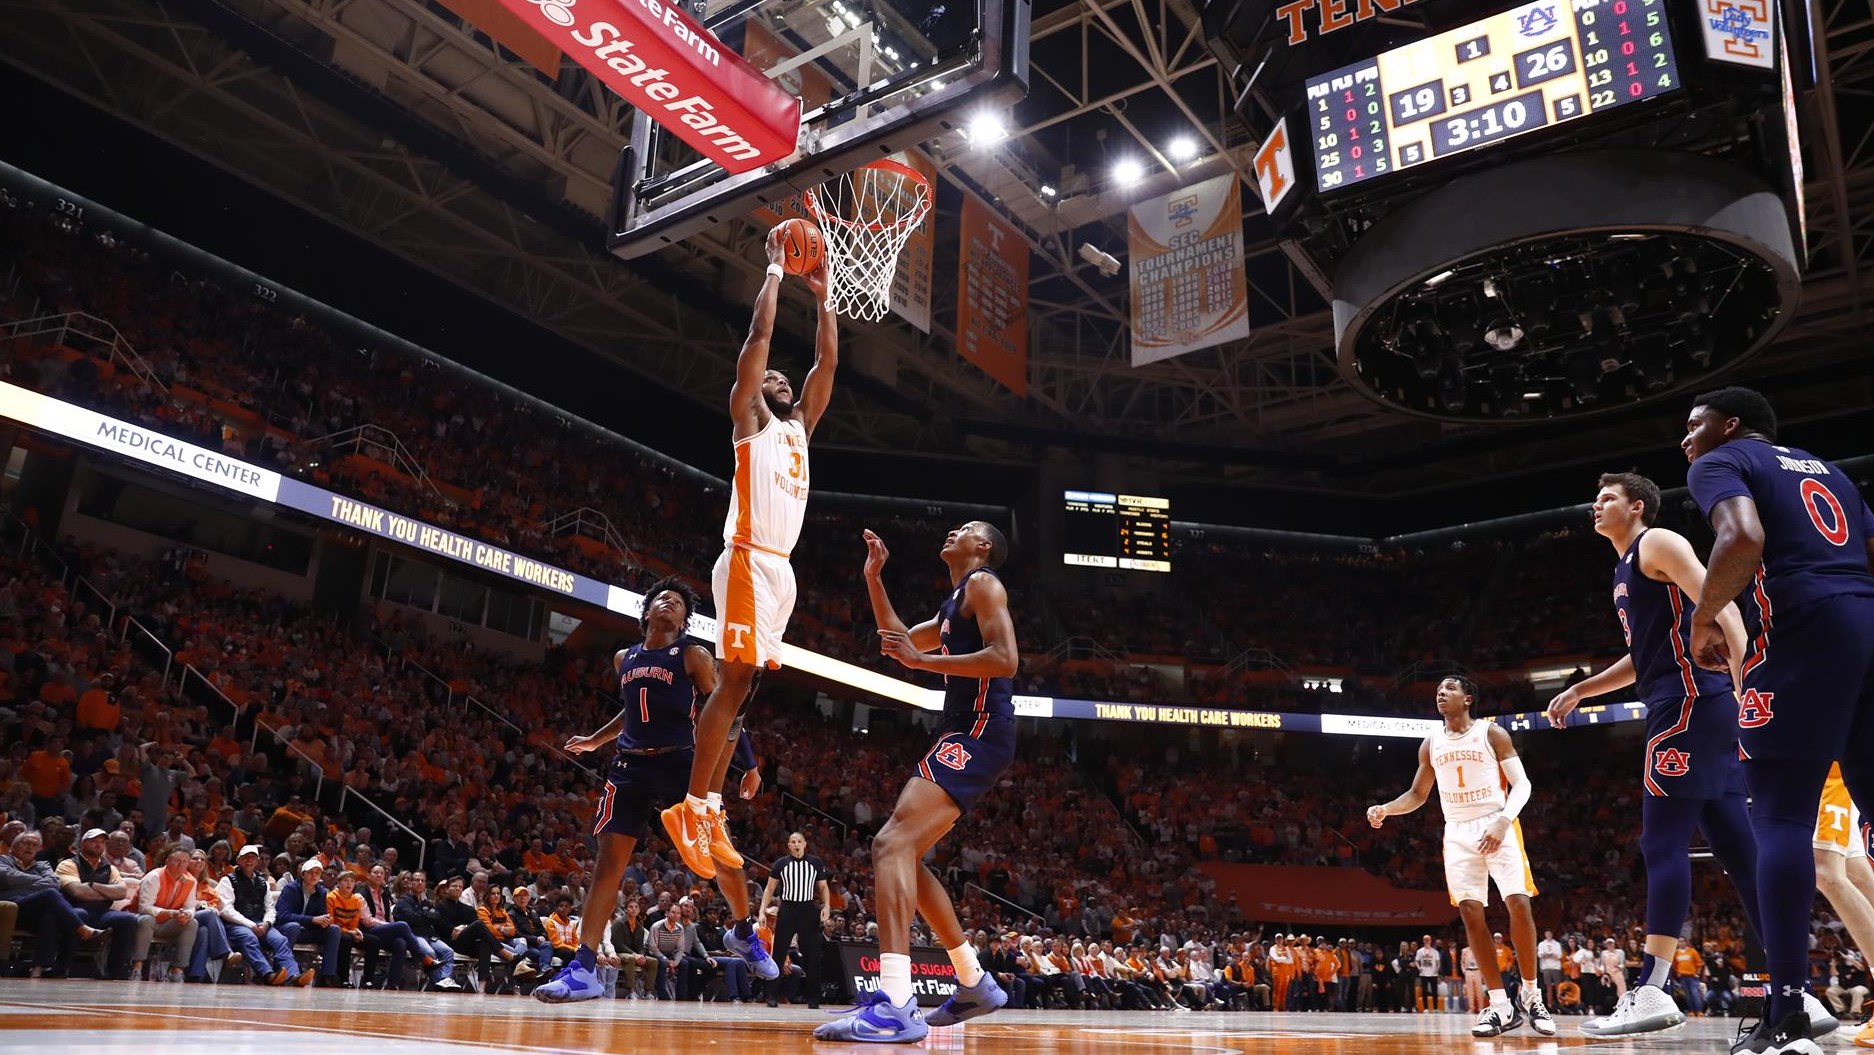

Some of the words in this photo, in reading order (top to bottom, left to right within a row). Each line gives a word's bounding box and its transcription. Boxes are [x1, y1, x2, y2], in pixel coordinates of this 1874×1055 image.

[1276, 0, 1416, 46] TEN
[1582, 11, 1595, 26] 0
[1586, 31, 1599, 46] 1
[1619, 21, 1631, 36] 1
[1647, 11, 1660, 26] 5
[1708, 17, 1769, 42] Volunteers
[1723, 8, 1751, 27] Lady
[1467, 41, 1482, 59] 1
[1526, 45, 1567, 79] 26
[1585, 49, 1608, 67] 10
[1622, 41, 1635, 55] 0
[1649, 32, 1664, 47] 6
[1494, 75, 1509, 90] 4
[1589, 69, 1612, 87] 13
[1627, 62, 1639, 76] 1
[1653, 53, 1668, 68] 2
[1318, 99, 1328, 111] 1
[1344, 91, 1354, 103] 1
[1365, 84, 1376, 96] 2
[1400, 88, 1435, 118] 19
[1453, 87, 1466, 104] 3
[1591, 90, 1616, 108] 22
[1630, 82, 1643, 97] 0
[1658, 73, 1671, 88] 4
[1320, 117, 1330, 130] 5
[1346, 109, 1357, 121] 0
[1368, 102, 1379, 114] 0
[1560, 99, 1575, 115] 5
[1318, 133, 1338, 149] 10
[1350, 128, 1359, 140] 1
[1370, 121, 1381, 134] 2
[1447, 101, 1526, 146] 3:10
[1321, 152, 1340, 169] 25
[1351, 146, 1362, 159] 0
[1373, 139, 1384, 152] 3
[1406, 146, 1419, 161] 5
[1322, 171, 1342, 187] 30
[1355, 165, 1365, 178] 1
[1376, 158, 1386, 171] 5
[55, 198, 84, 220] 321
[1137, 232, 1235, 272] TOURNAMENT
[1169, 230, 1199, 250] SEC
[1139, 247, 1234, 285] CHAMPIONS
[254, 283, 278, 304] 322
[97, 421, 186, 464] MEDICAL
[193, 453, 261, 488] CENTER
[1776, 455, 1831, 475] JOHNSON
[1800, 478, 1849, 546] 0
[331, 496, 384, 532] THANK
[387, 517, 417, 542] YOU
[420, 526, 473, 561] HEALTH
[476, 545, 511, 573] CARE
[513, 557, 575, 594] WORKERS
[727, 622, 752, 648] T
[621, 666, 674, 689] AUBURN
[640, 687, 649, 723] 1
[1095, 703, 1132, 722] THANK
[1135, 706, 1156, 723] YOU
[1159, 707, 1198, 726] HEALTH
[1200, 709, 1228, 727] CARE
[1230, 711, 1281, 729] WORKERS
[1348, 719, 1390, 730] MEDICAL
[1395, 721, 1432, 732] CENTER
[1435, 751, 1484, 767] TENNESSEE
[1457, 766, 1466, 788] 1
[1441, 785, 1492, 804] VOLUNTEERS
[1825, 804, 1849, 831] T
[860, 956, 880, 973] Cok
[921, 963, 954, 976] SUGAR
[854, 976, 880, 993] Full
[926, 979, 957, 995] Flav
